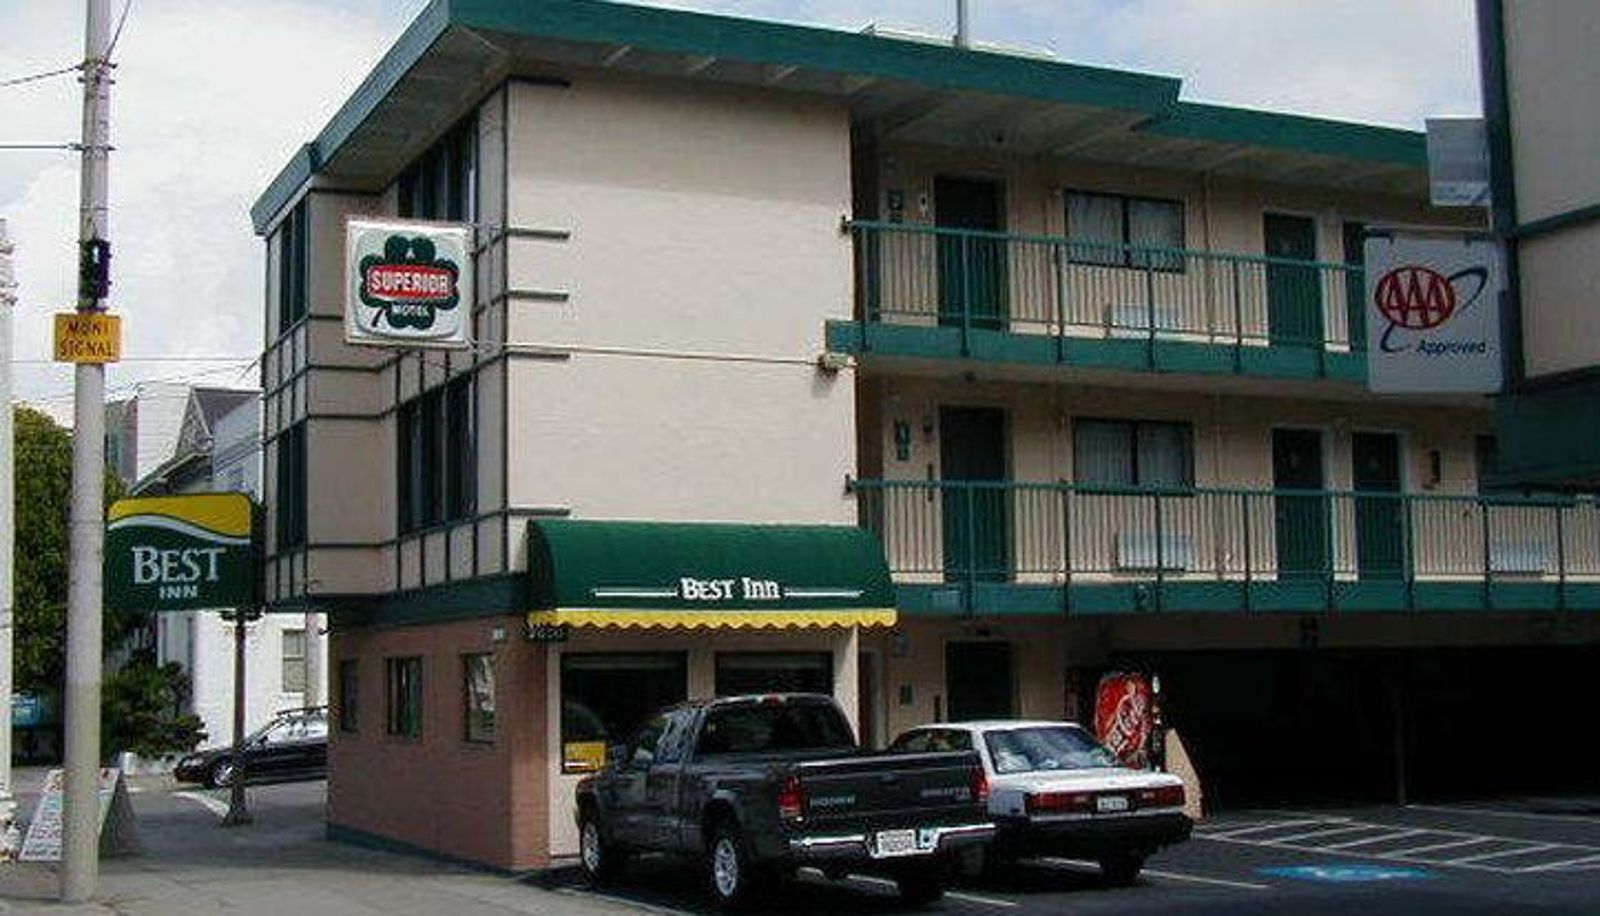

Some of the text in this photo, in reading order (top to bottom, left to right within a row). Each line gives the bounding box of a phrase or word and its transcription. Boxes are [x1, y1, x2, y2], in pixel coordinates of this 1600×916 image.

[370, 270, 449, 293] SUPERIOR
[1381, 268, 1450, 327] AAA
[60, 337, 116, 357] SIGNAL
[1416, 340, 1486, 356] Approved
[131, 545, 227, 584] BEST
[159, 585, 198, 599] INN
[741, 577, 780, 599] Inn
